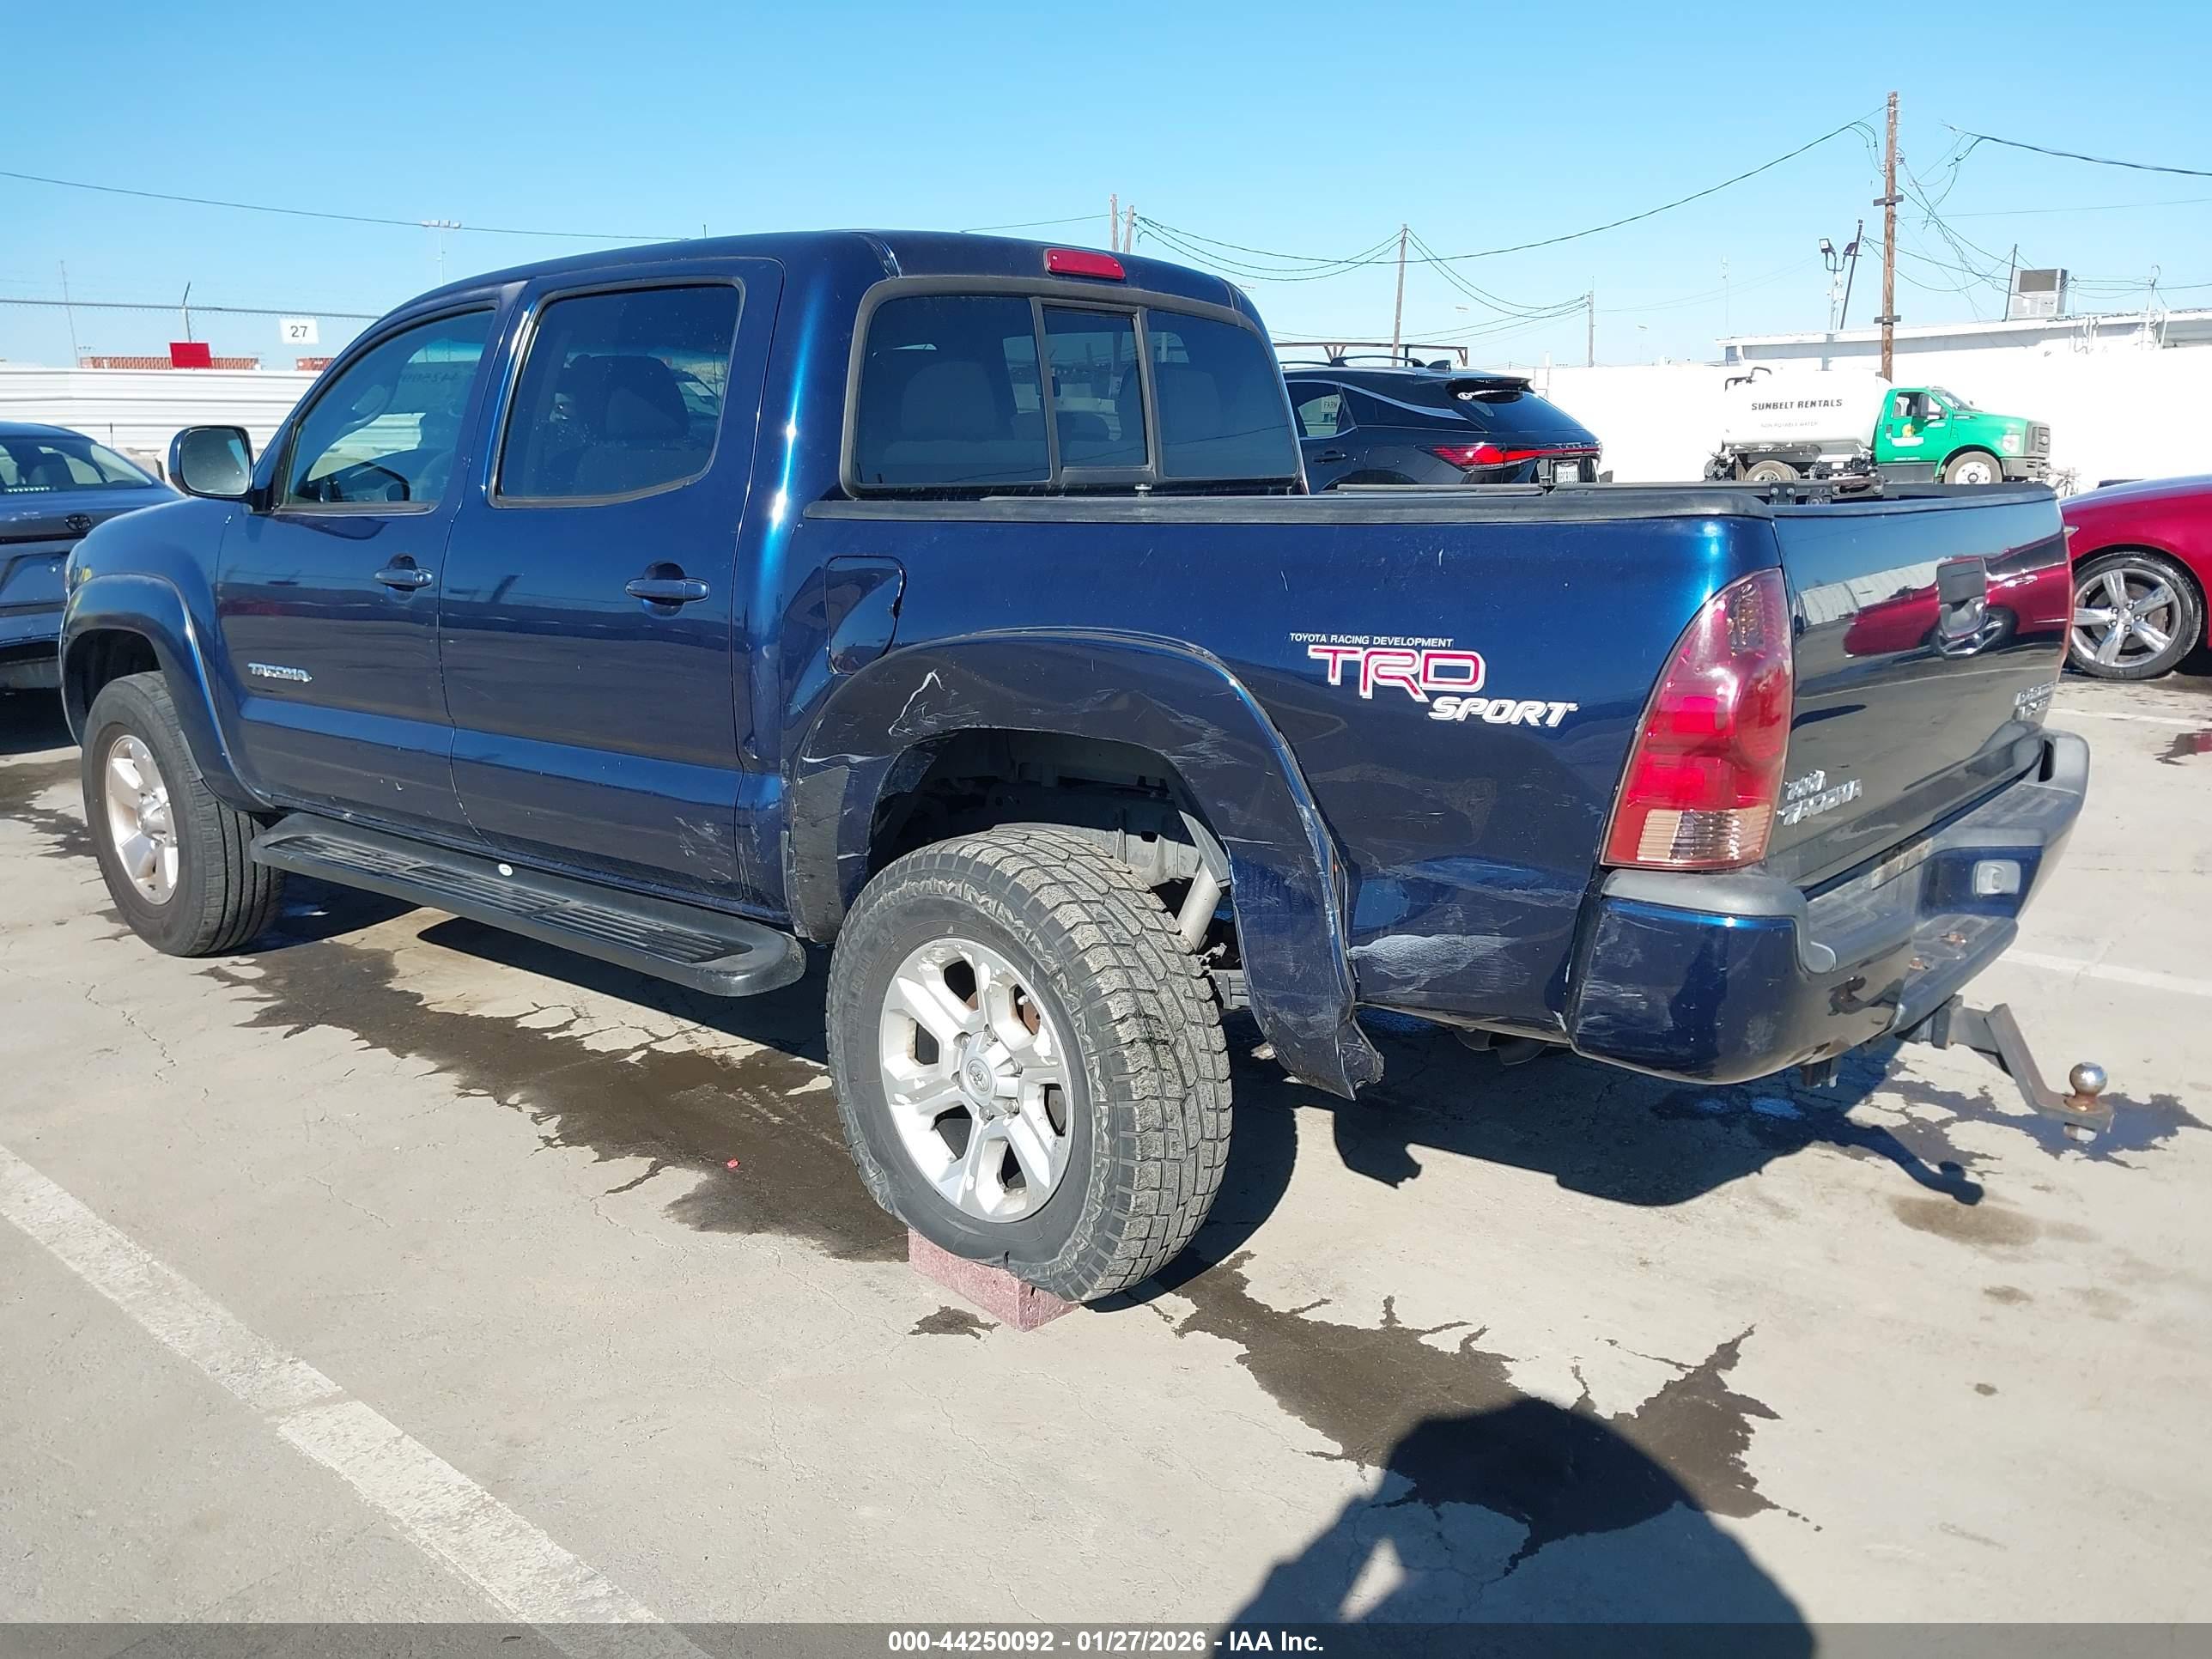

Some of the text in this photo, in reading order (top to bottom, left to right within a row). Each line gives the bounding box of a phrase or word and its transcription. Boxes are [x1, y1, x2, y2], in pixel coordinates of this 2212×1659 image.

[289, 325, 308, 337] 27
[1751, 399, 1843, 410] SUNBELT RENTALS
[1290, 633, 1454, 647] TOYOTA RACING DEVELOPMENT
[1307, 645, 1486, 702] TRD
[1428, 696, 1578, 727] SPORT
